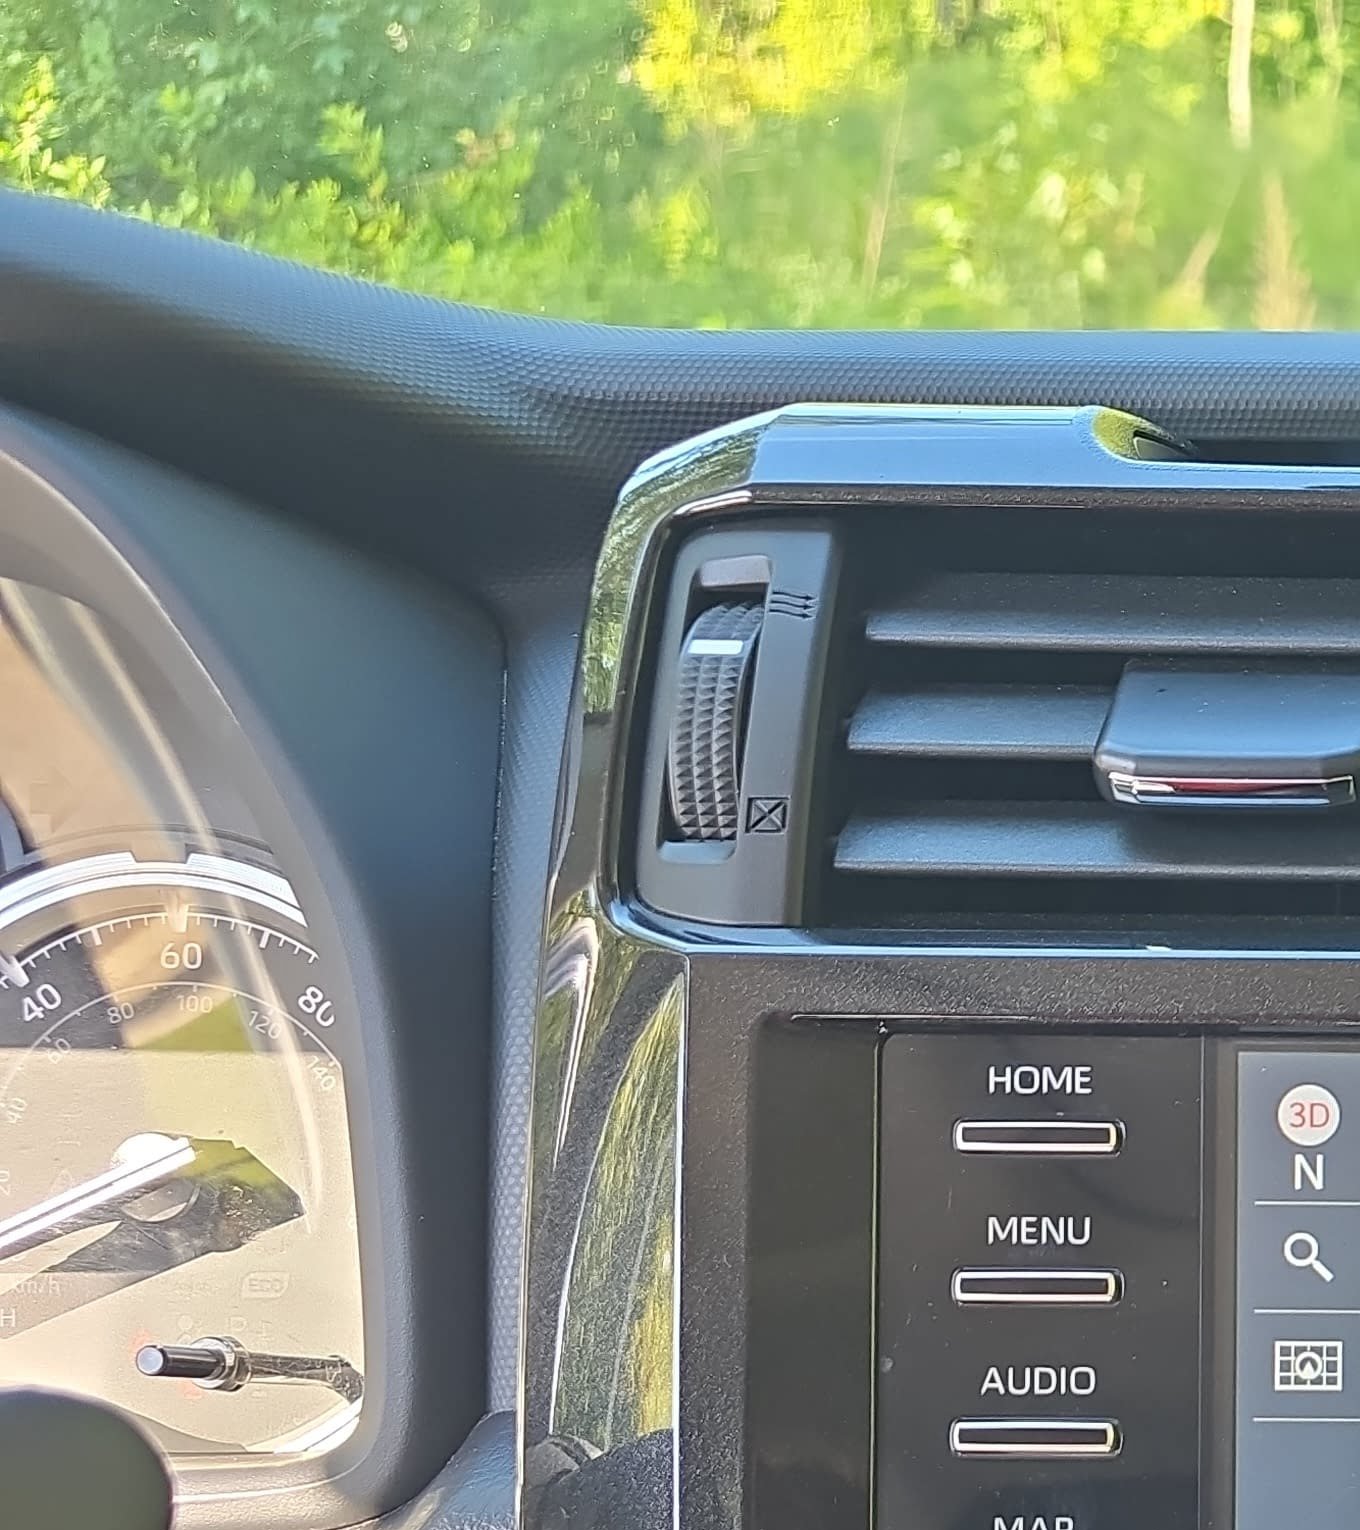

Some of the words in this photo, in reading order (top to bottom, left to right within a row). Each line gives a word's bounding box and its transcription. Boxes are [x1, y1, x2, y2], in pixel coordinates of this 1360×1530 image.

[159, 941, 203, 970] 60
[22, 984, 62, 1023] 40
[107, 1001, 136, 1024] 80
[177, 994, 213, 1014] 100
[247, 1009, 282, 1041] 120
[47, 1037, 72, 1064] 60
[306, 1055, 336, 1092] 140
[987, 1066, 1092, 1095] HOME
[1289, 1102, 1330, 1129] 3D
[1294, 1154, 1325, 1191] N
[986, 1216, 1092, 1246] MENU
[980, 1366, 1097, 1396] AUDIO
